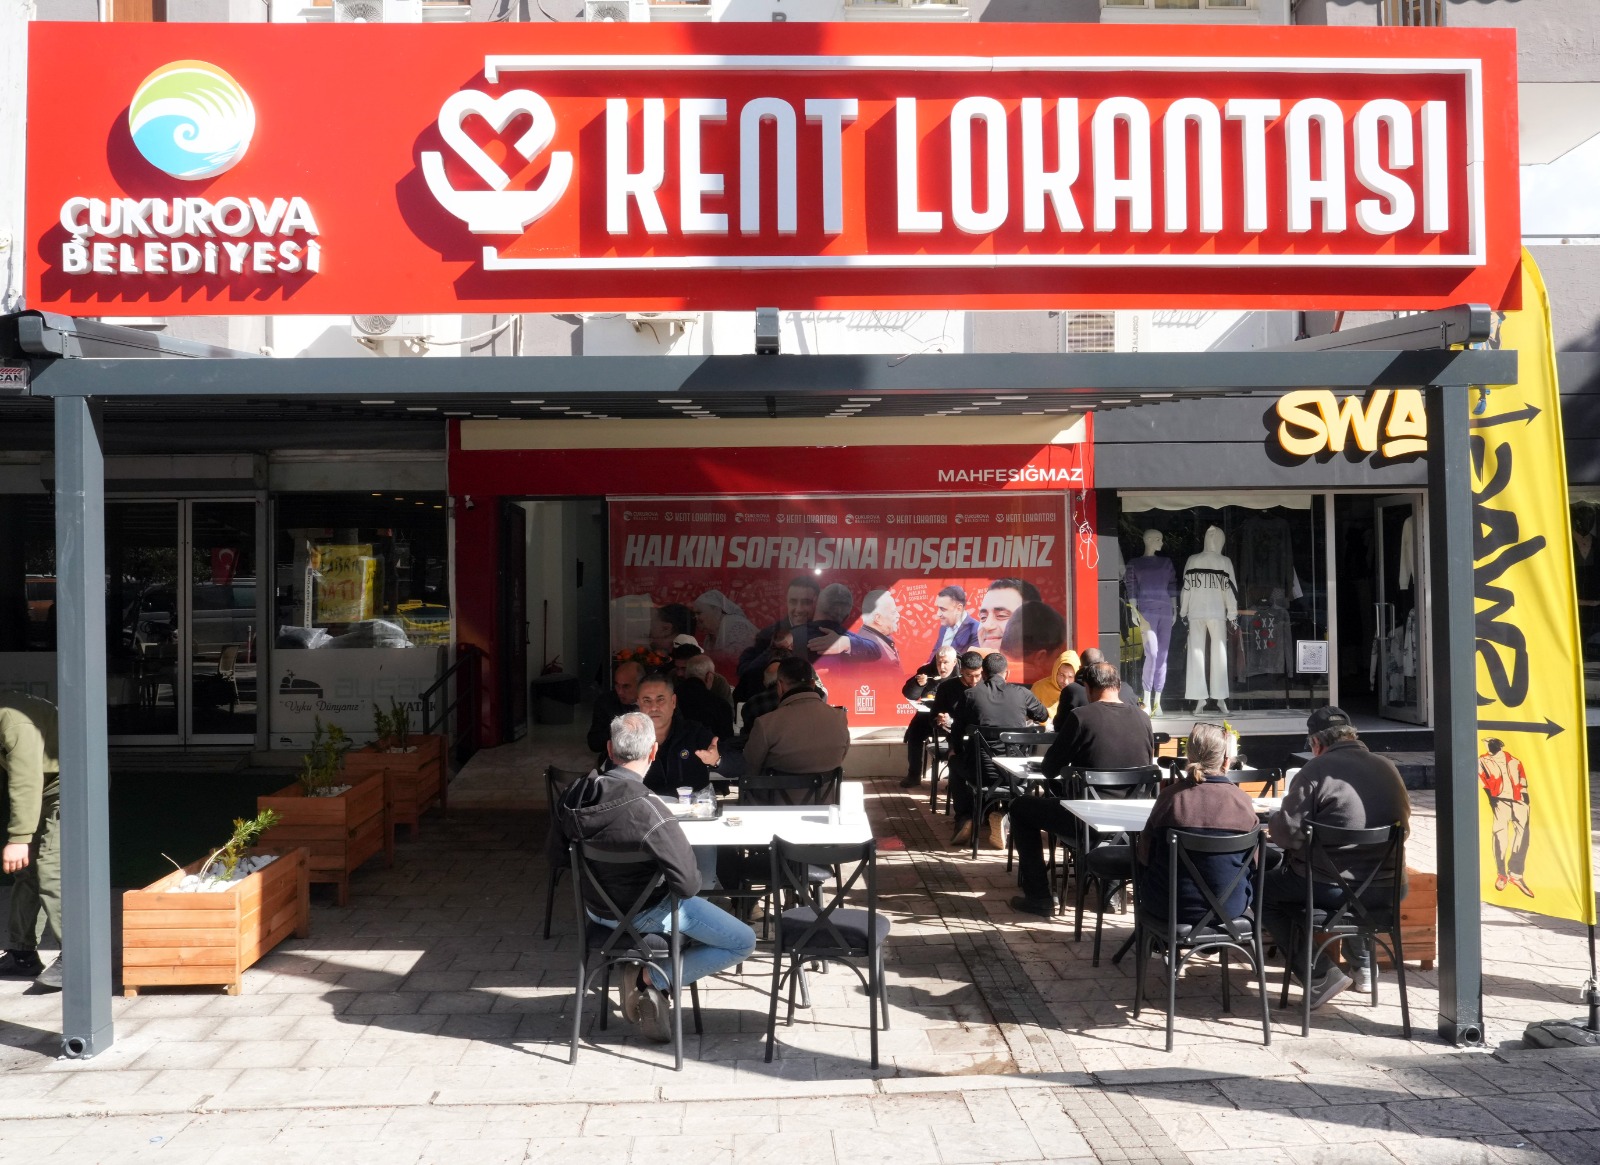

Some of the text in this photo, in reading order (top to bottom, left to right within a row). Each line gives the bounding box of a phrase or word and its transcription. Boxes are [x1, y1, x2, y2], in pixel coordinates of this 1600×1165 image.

[606, 96, 1450, 235] KENT LOKANTASI
[59, 196, 320, 241] ÇUKUROVA
[62, 240, 322, 276] BELEDİYESİ
[938, 464, 1083, 482] MAHFESIĞMAZ
[623, 534, 1055, 575] HALKIN SOFRASINA HOŞGELDİNİZ
